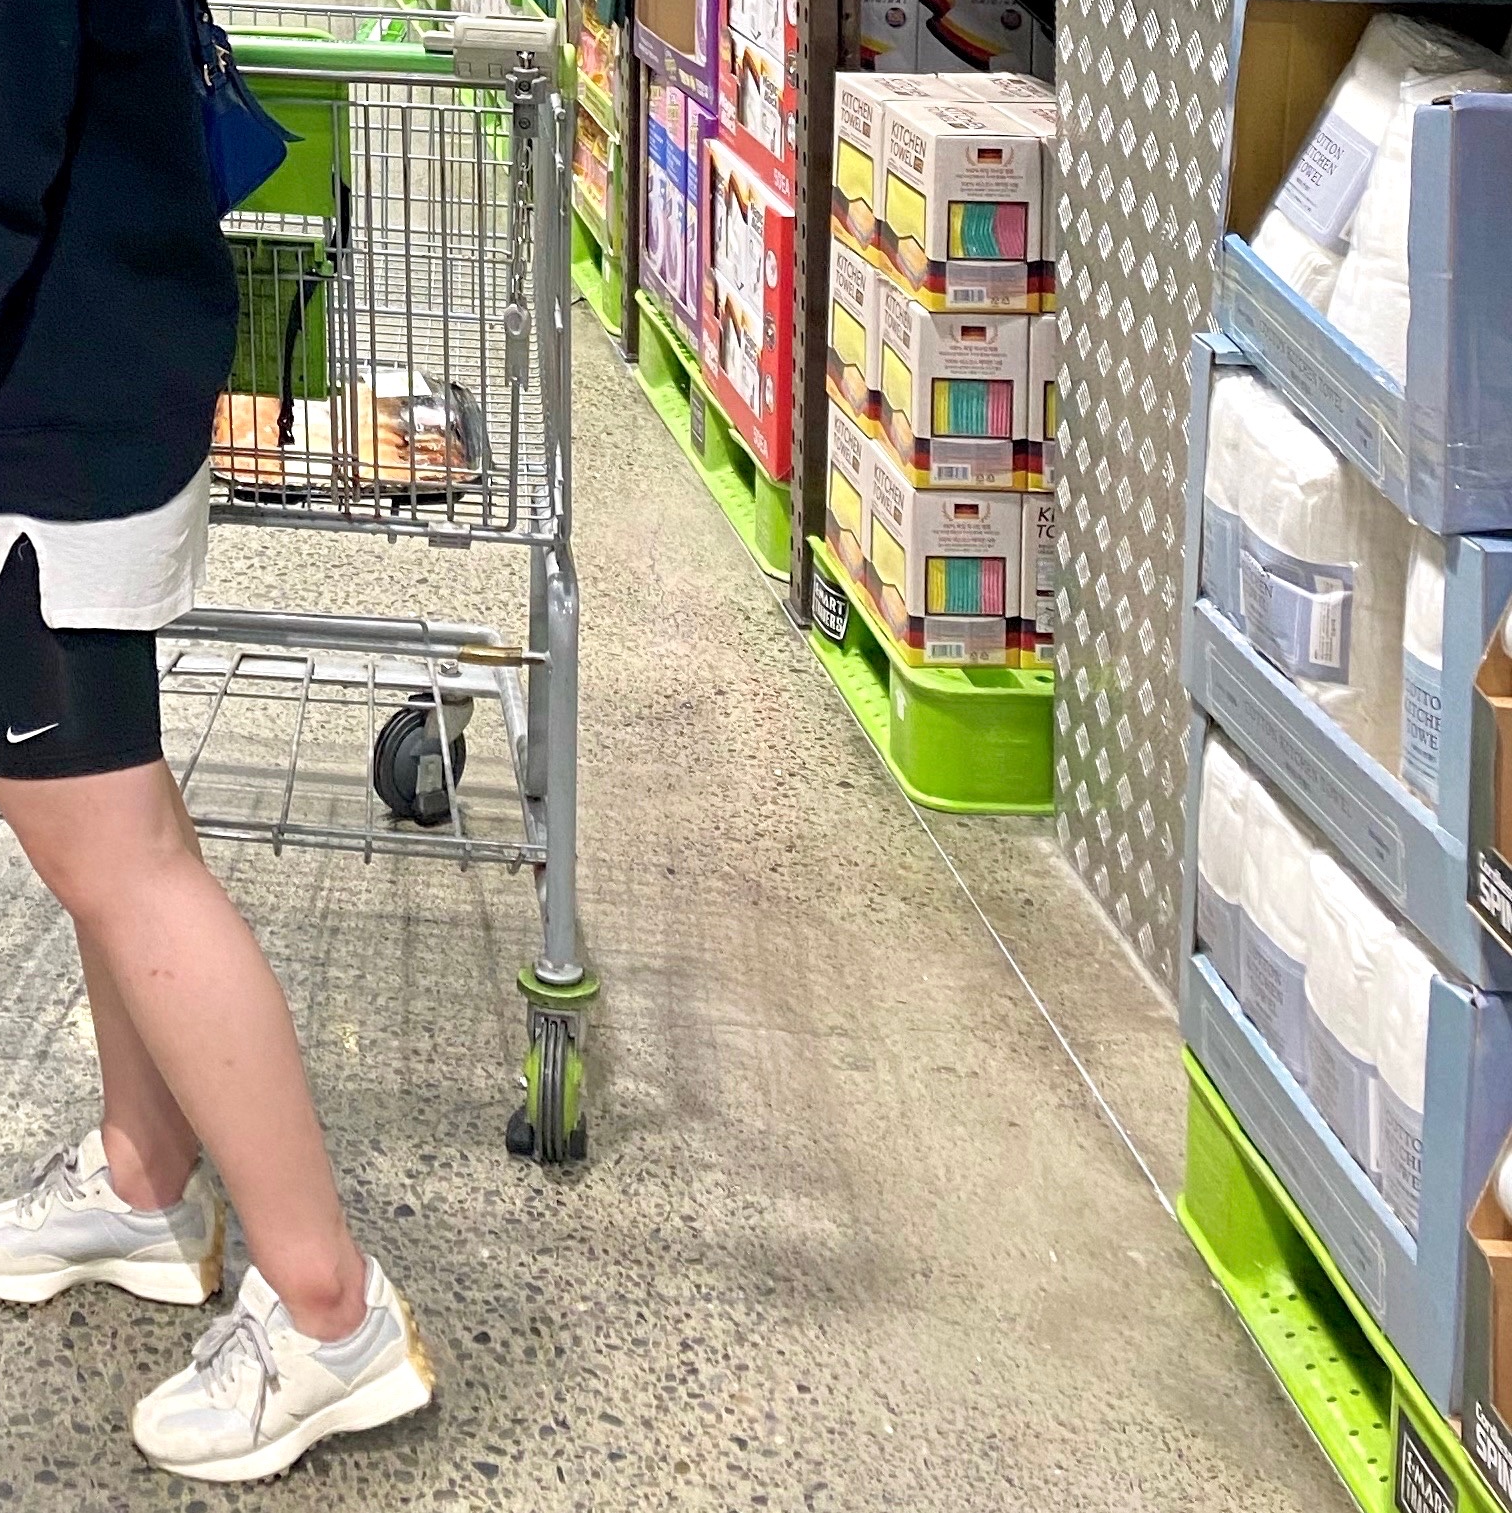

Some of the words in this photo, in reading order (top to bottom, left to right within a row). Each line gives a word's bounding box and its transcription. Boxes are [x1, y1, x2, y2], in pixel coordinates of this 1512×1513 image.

[840, 107, 862, 133] TOWEL
[841, 88, 873, 123] KITCHEN
[889, 138, 913, 167] TOWEL
[891, 120, 927, 159] KITCHEN
[1297, 158, 1323, 187] TOWEL
[836, 268, 857, 300] TOWEL
[837, 252, 867, 290] KITCHEN
[884, 310, 904, 343] TOWEL
[885, 293, 913, 332] KITCHEN
[833, 431, 853, 465] TOWEL
[834, 414, 862, 460] KITCHEN
[873, 481, 895, 517] TOWEL
[874, 462, 905, 510] KITCHEN
[1407, 719, 1441, 751] TOWE
